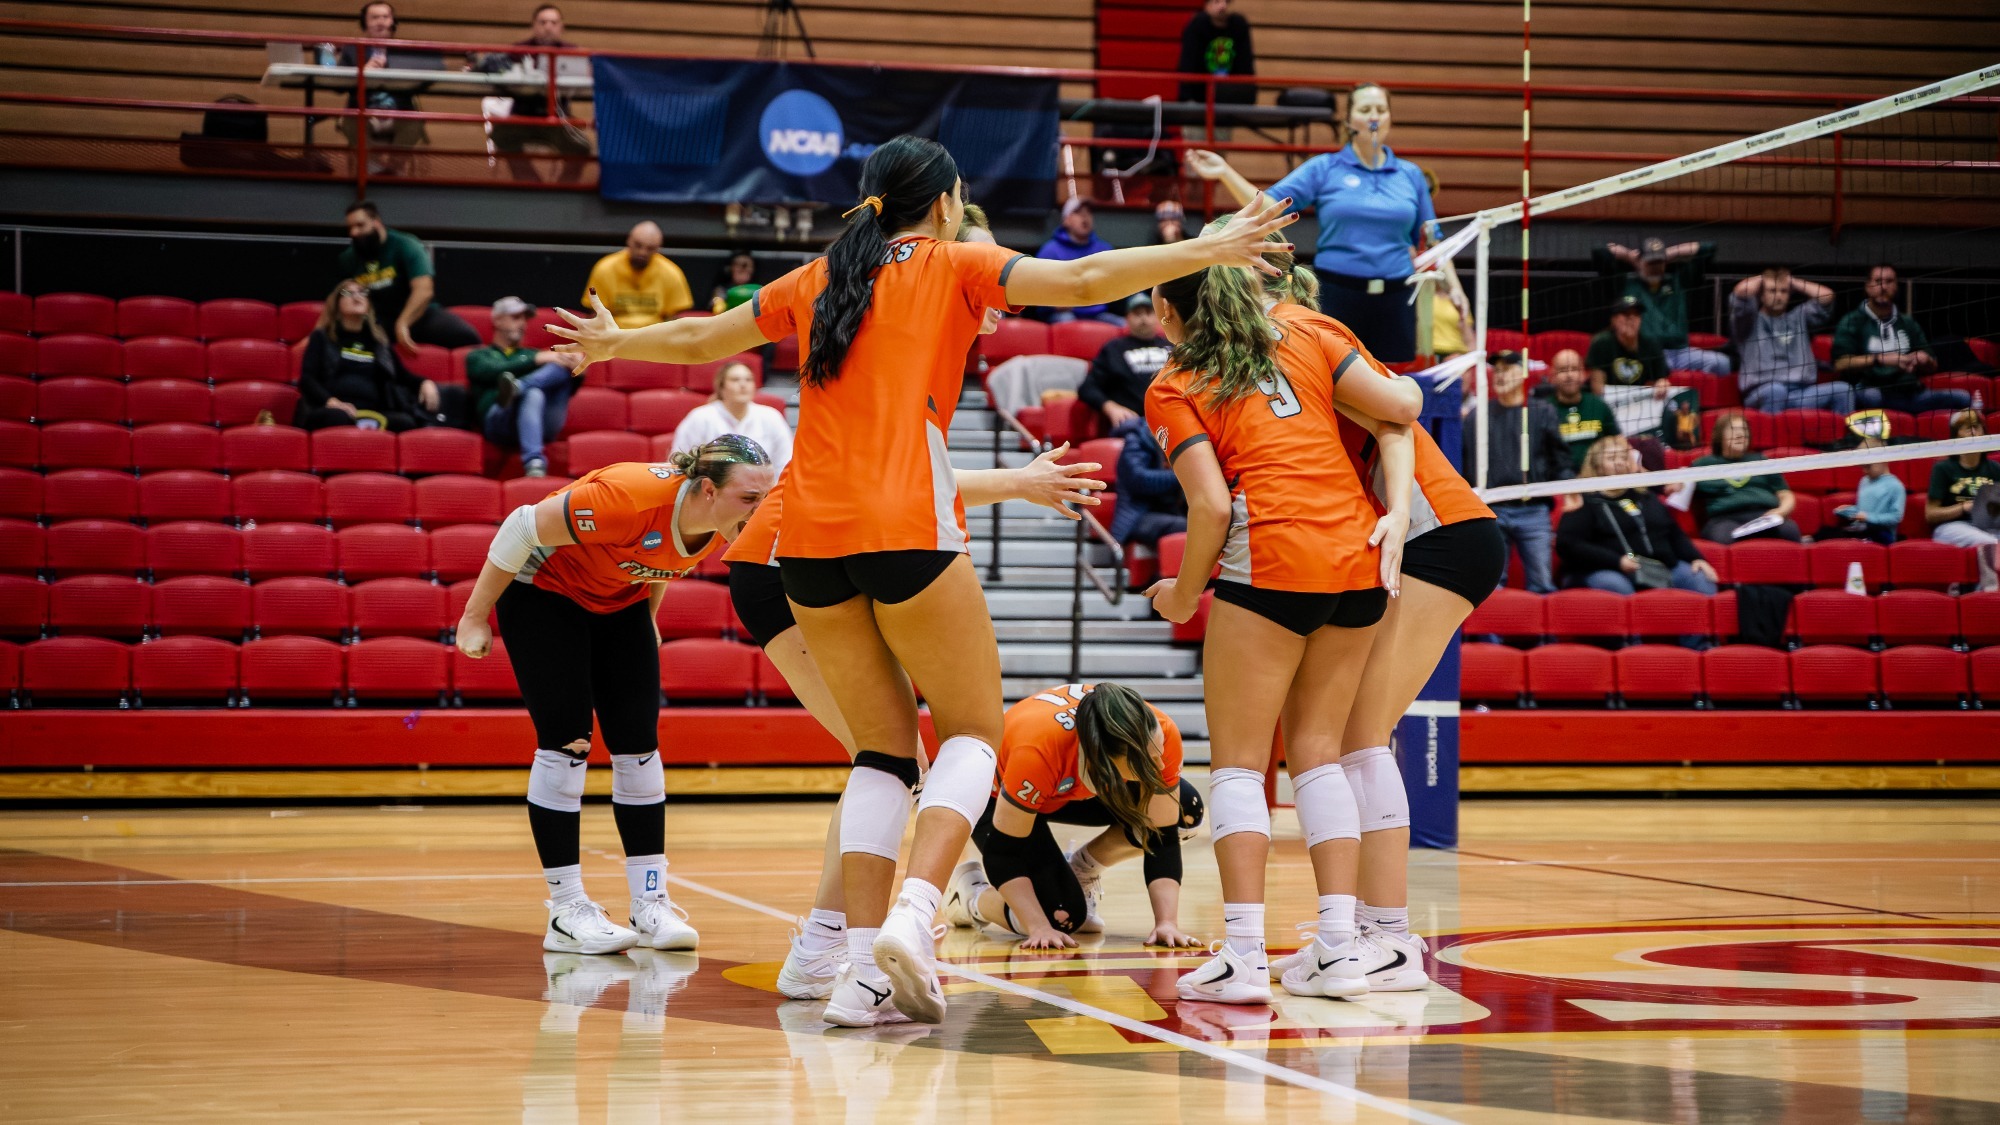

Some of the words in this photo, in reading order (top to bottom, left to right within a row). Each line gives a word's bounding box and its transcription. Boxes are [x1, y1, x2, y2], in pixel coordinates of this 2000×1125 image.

[769, 129, 840, 157] NCAA
[1255, 364, 1303, 418] 9
[574, 507, 597, 532] 15
[1016, 779, 1041, 805] 21
